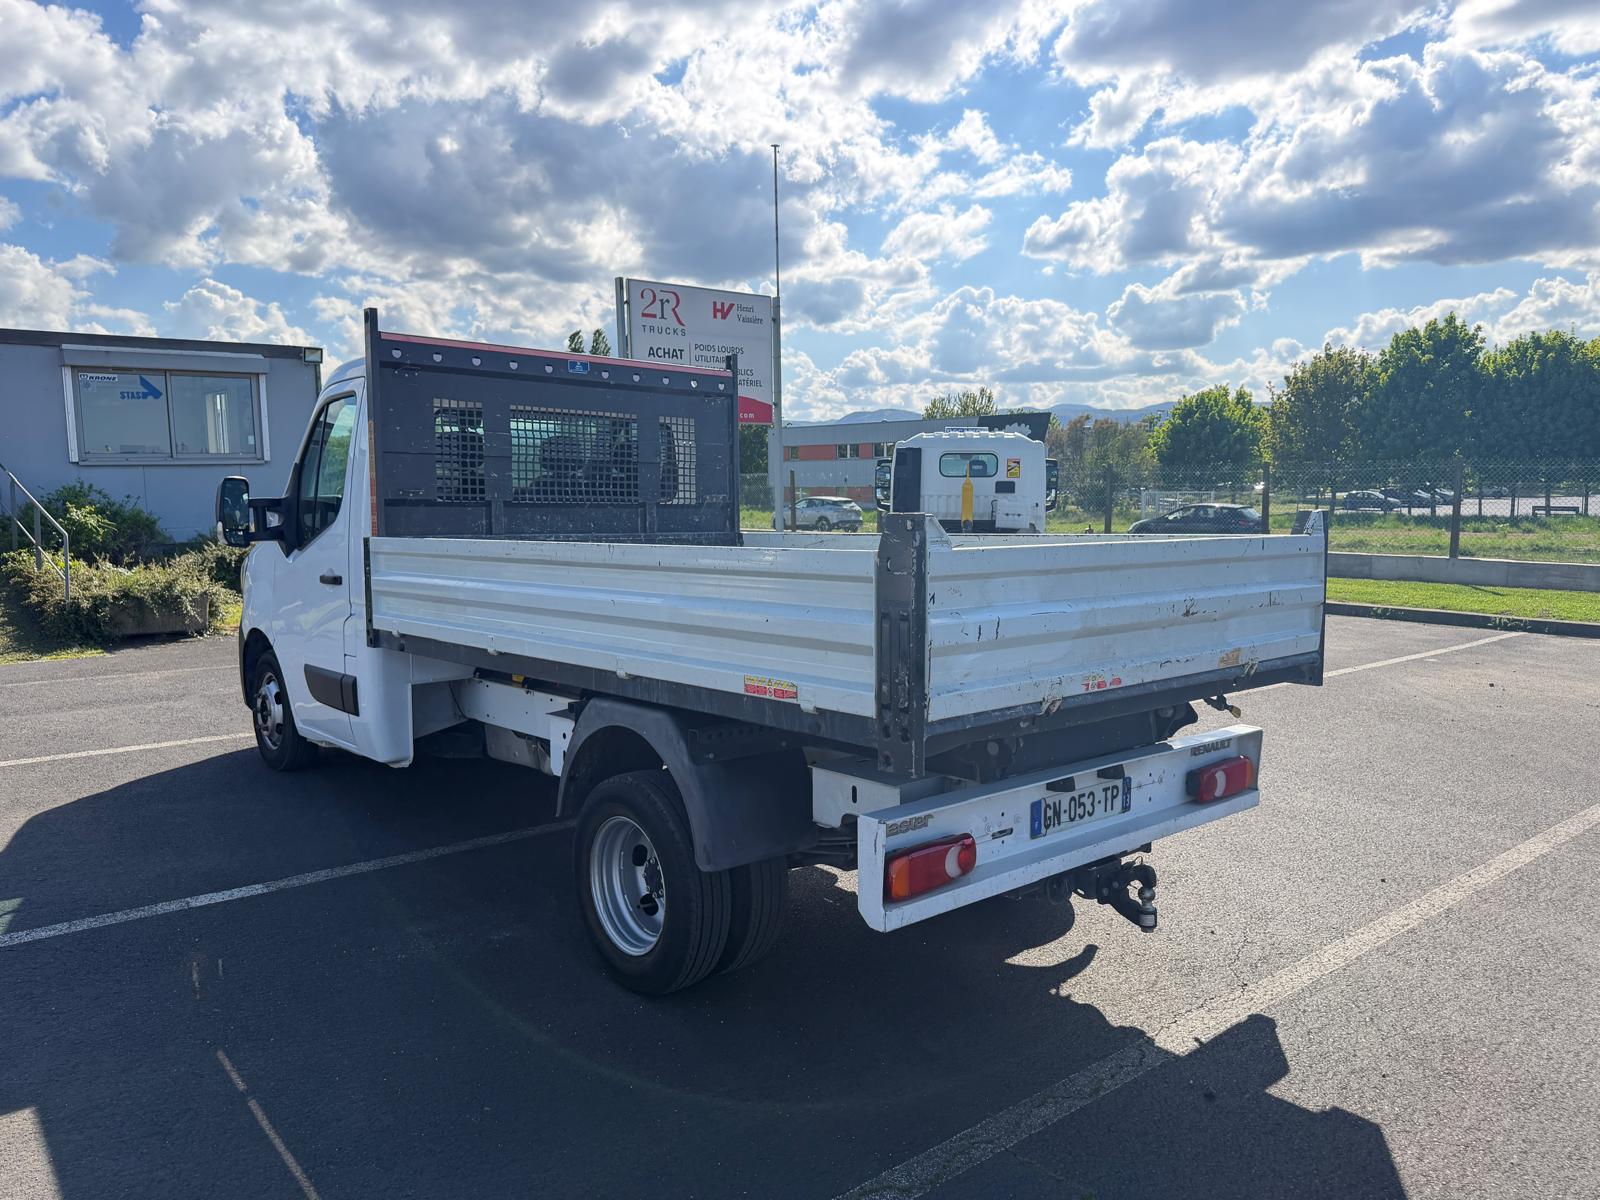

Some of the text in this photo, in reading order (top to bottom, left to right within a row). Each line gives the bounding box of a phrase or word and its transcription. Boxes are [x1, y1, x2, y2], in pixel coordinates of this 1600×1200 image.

[712, 301, 735, 320] HV
[737, 303, 754, 313] Henri
[737, 314, 763, 325] Vaissière
[641, 324, 686, 337] TRUCKS
[648, 346, 684, 360] ACHAT
[694, 343, 744, 355] POIDS LOURDS
[694, 355, 726, 364] UTILITAIR
[737, 368, 754, 377] BLICS
[737, 377, 763, 388] ATÉRIEL
[1190, 738, 1233, 757] RENAULT
[1043, 784, 1119, 830] GN-053-TP
[886, 813, 934, 837] aster
